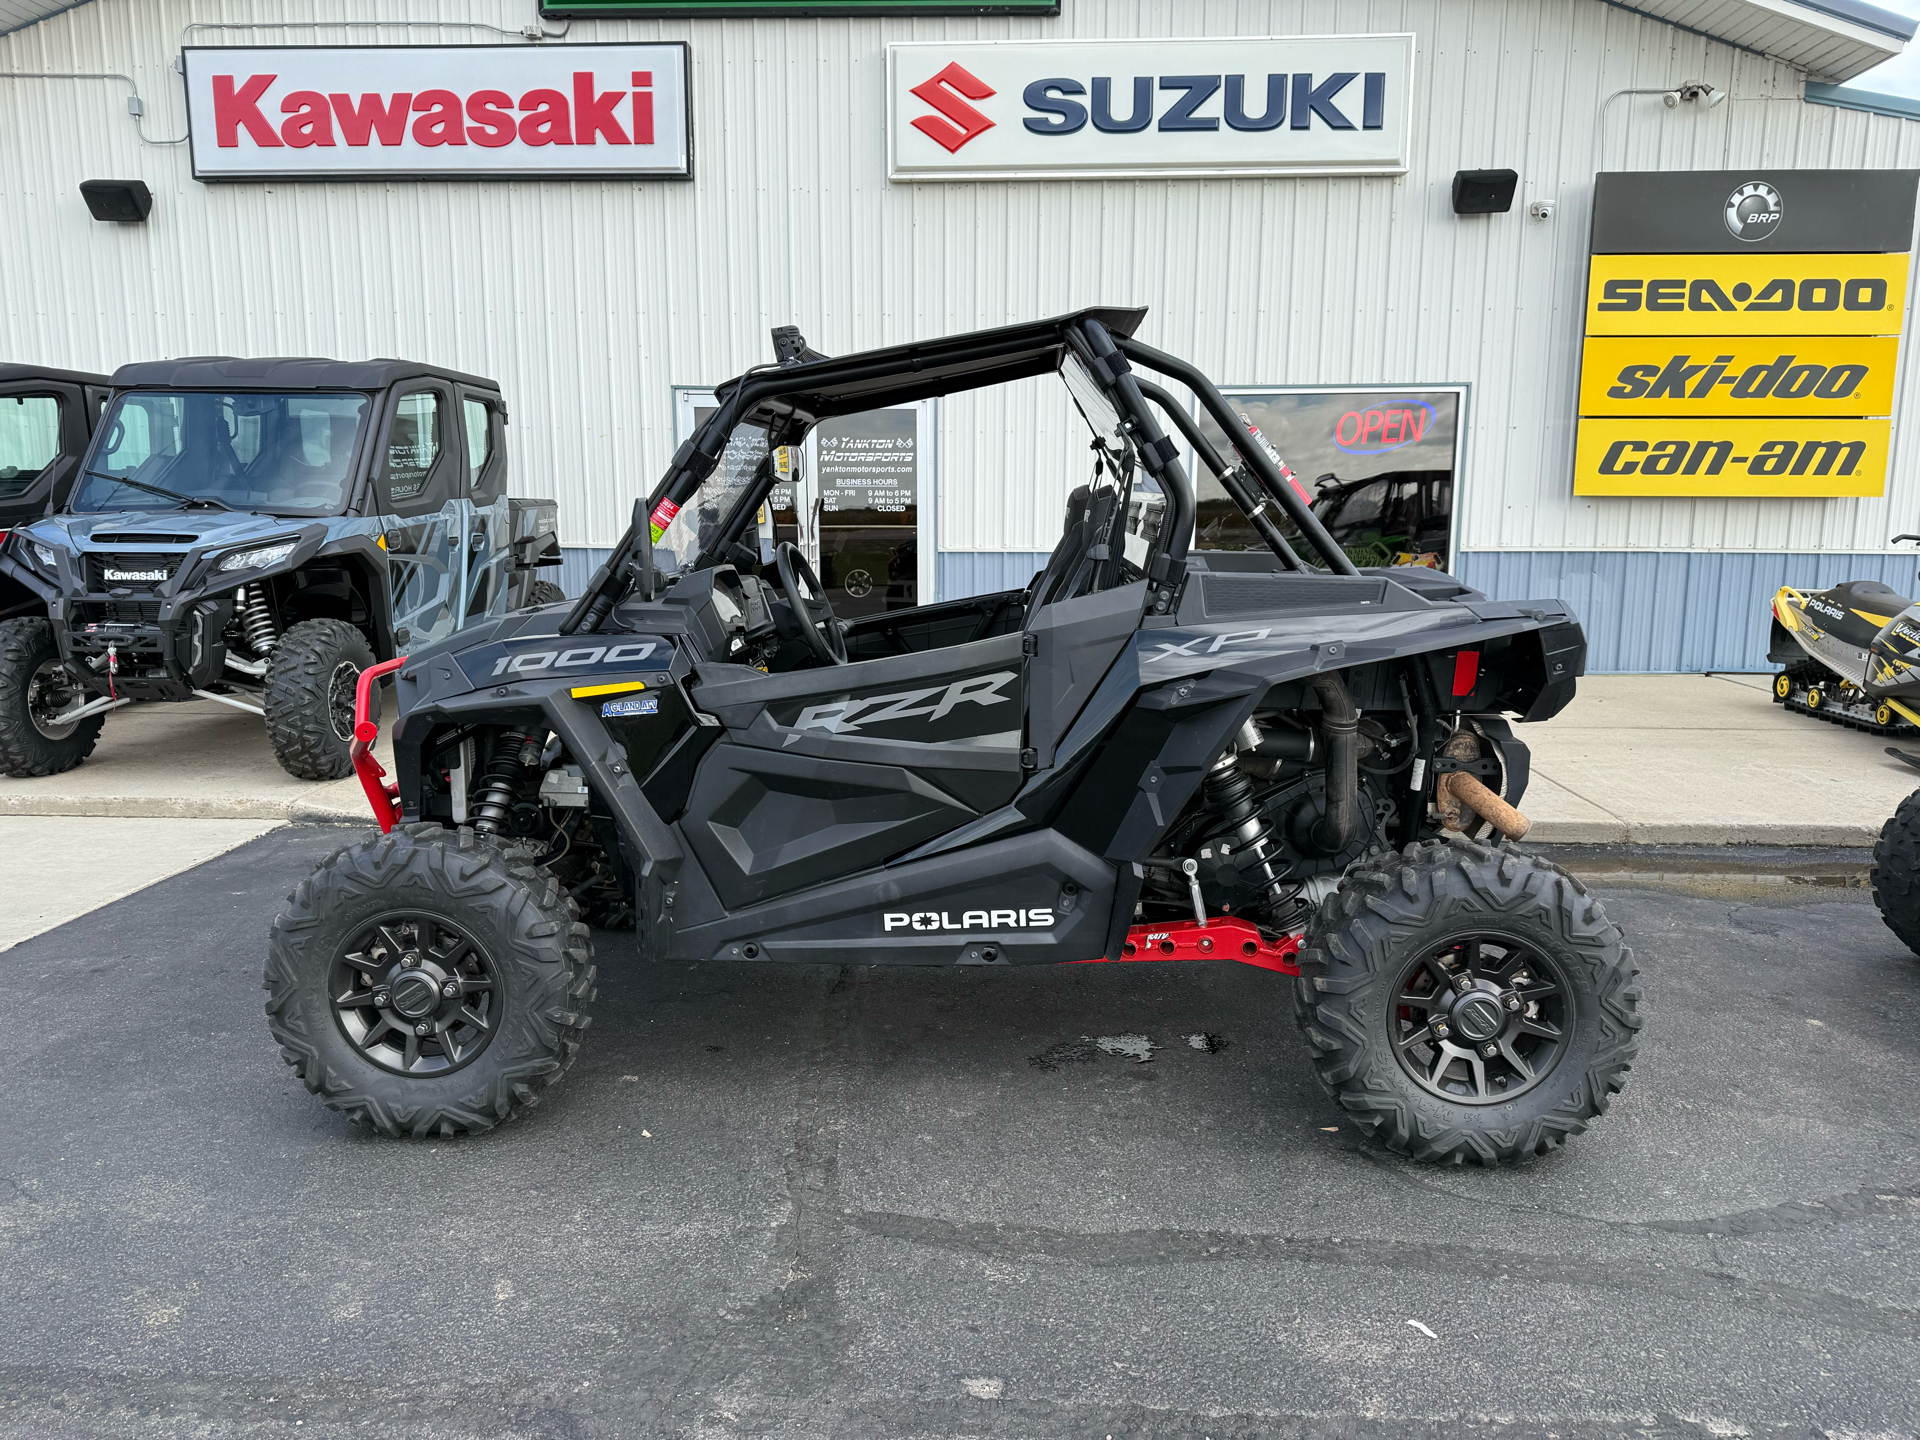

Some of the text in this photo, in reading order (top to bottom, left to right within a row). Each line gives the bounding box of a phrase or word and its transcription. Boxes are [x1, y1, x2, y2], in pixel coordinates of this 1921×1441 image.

[211, 71, 655, 148] Kawasaki
[1022, 71, 1385, 136] SUZUKI
[1746, 213, 1780, 223] BRP
[1606, 354, 1870, 399] ski-doo
[1334, 408, 1427, 446] OPEN
[820, 450, 914, 462] MOTORSPORTS
[840, 437, 895, 449] YANKTON
[821, 465, 913, 474] yanktonmotorsports.com
[1597, 440, 1866, 476] can-am
[836, 478, 898, 486] BUSINESS HOURS
[104, 569, 168, 581] Kawasaki
[1808, 599, 1846, 621] POLARIS
[1144, 627, 1273, 664] XP
[491, 642, 657, 677] 1000
[642, 700, 657, 710] ATV
[781, 670, 1018, 747] RZR
[882, 907, 1055, 933] POLARIS
